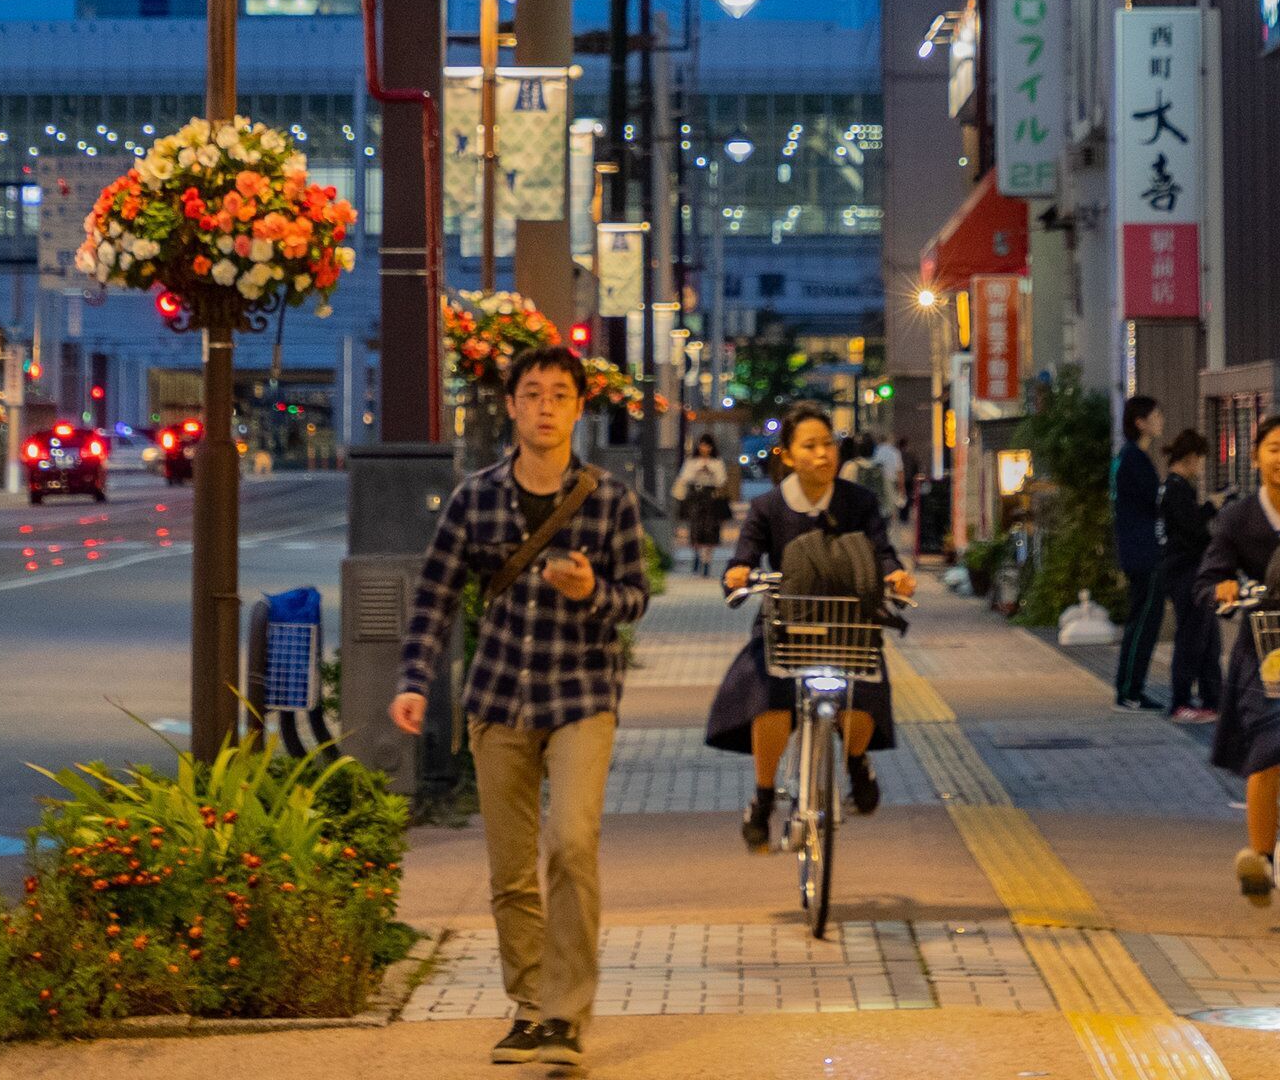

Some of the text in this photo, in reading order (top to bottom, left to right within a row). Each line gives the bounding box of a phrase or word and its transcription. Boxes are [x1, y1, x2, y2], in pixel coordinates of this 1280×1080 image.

[1010, 162, 1056, 189] 2F
[1150, 228, 1176, 305] 駅前店
